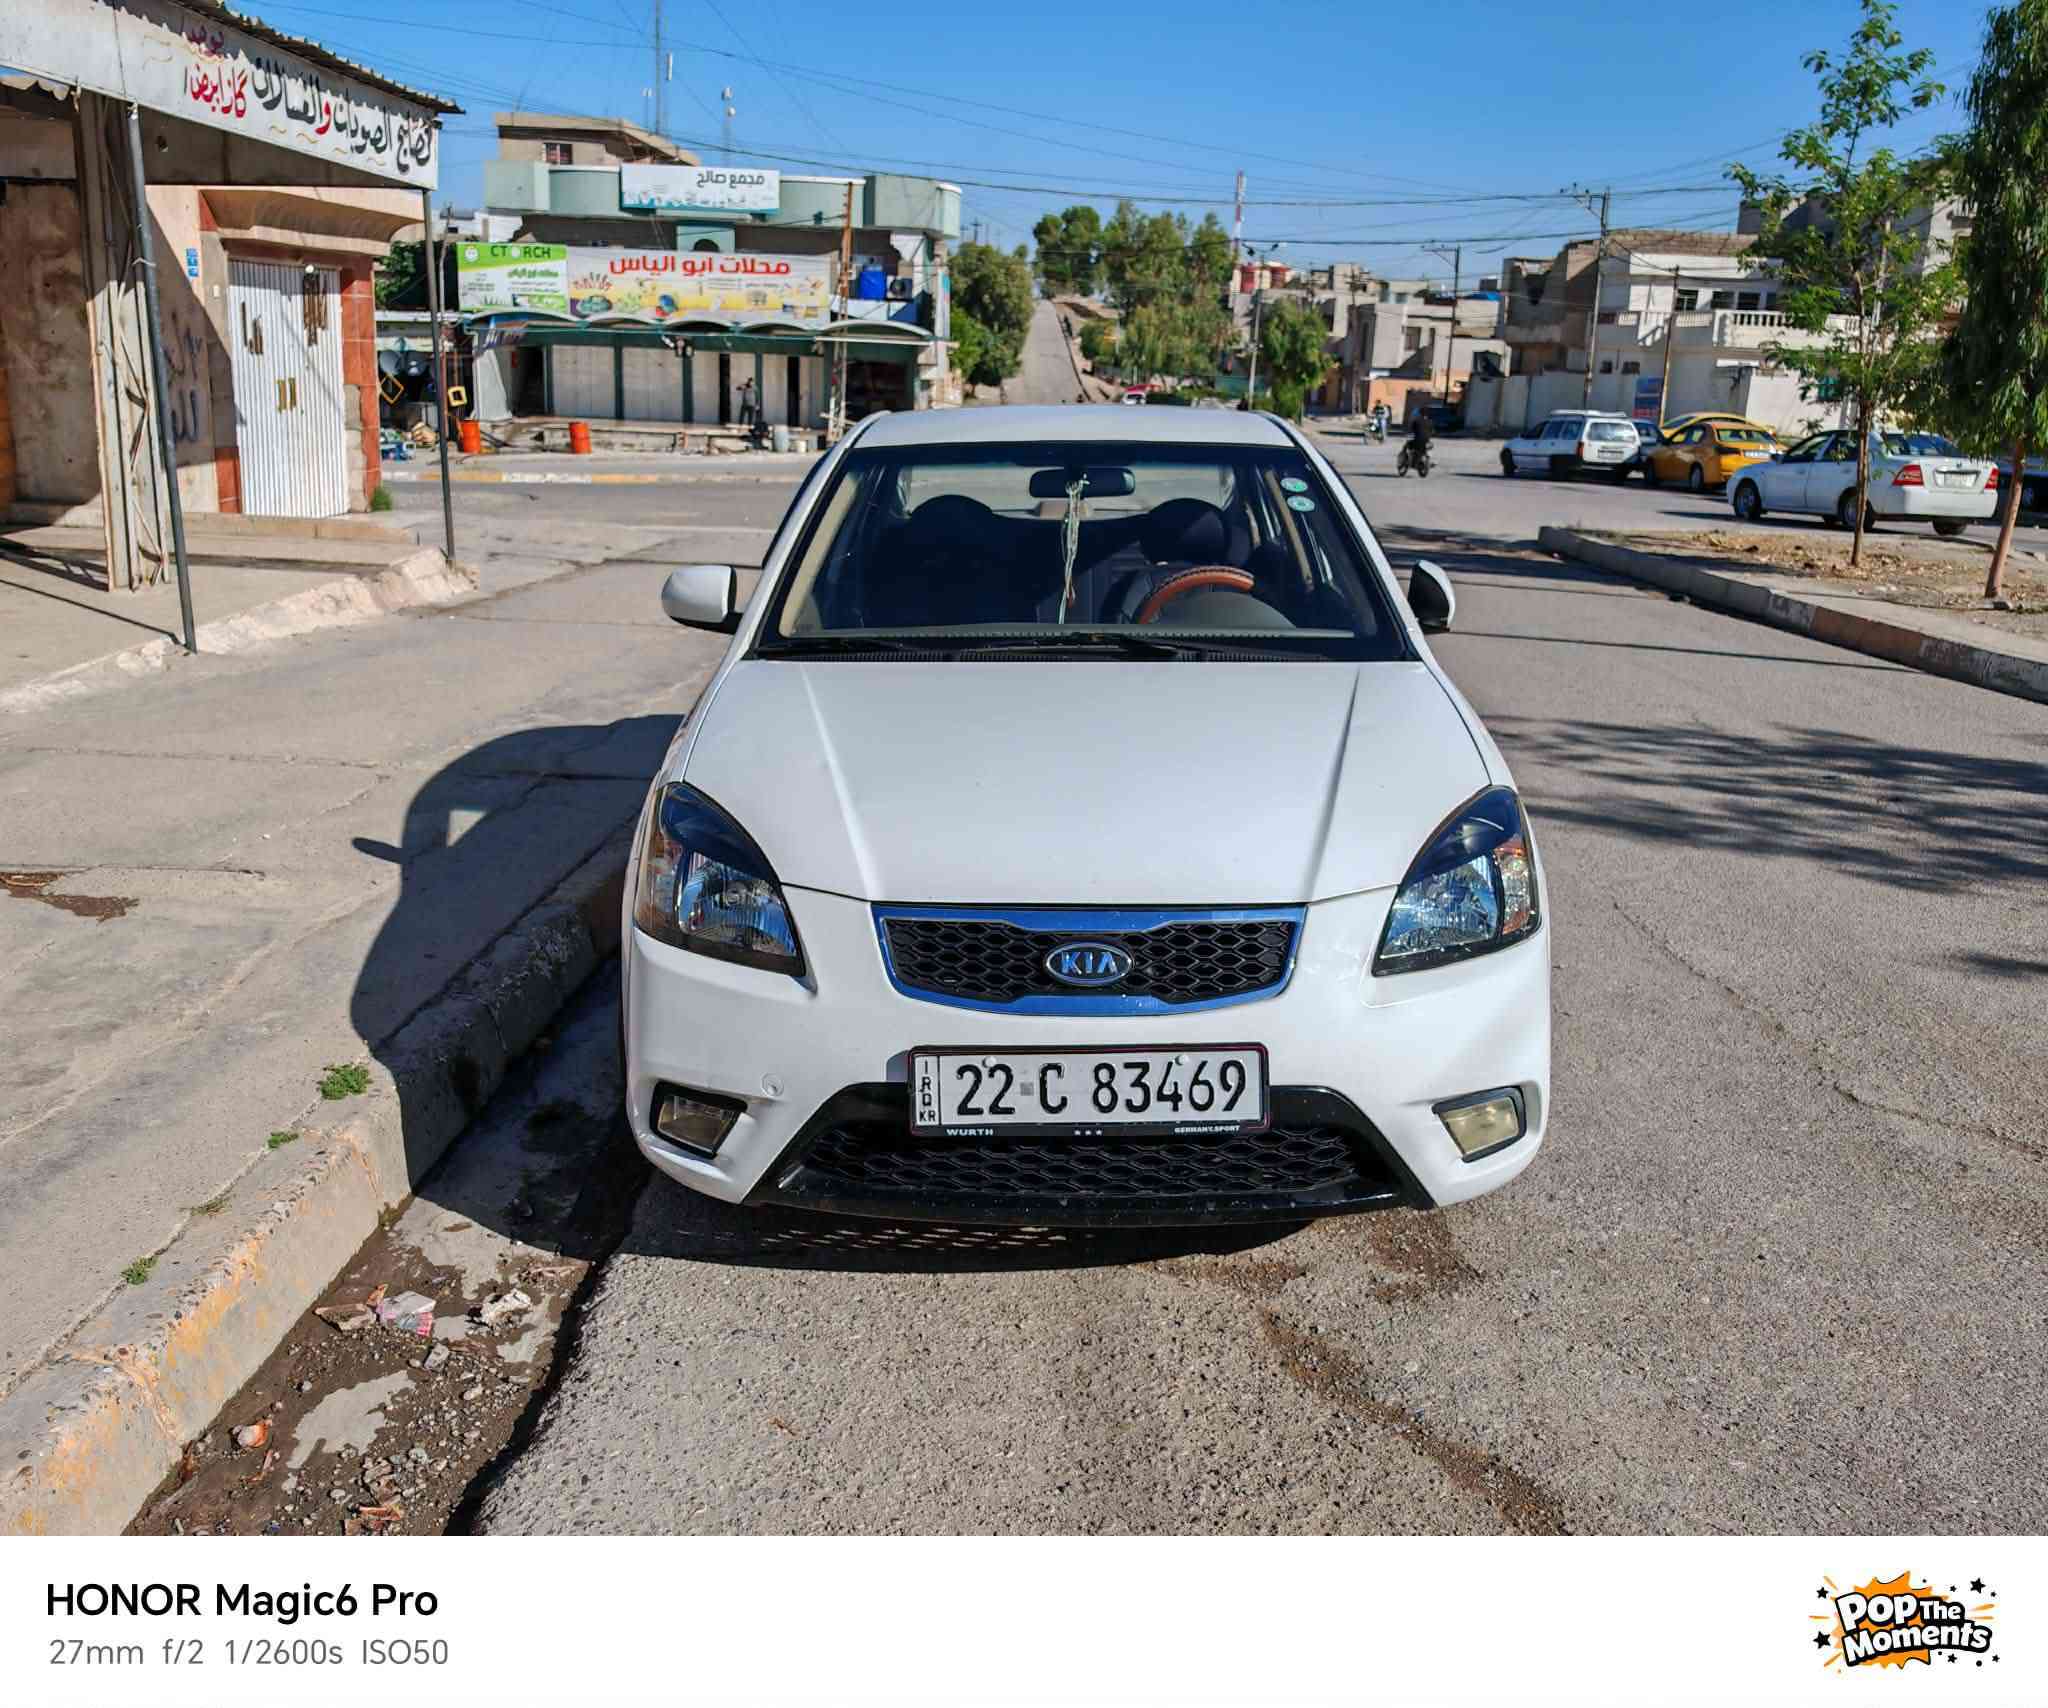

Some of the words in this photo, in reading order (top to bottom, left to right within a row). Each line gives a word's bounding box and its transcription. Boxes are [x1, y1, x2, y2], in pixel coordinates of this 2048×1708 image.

[697, 170, 727, 188] صالح
[729, 174, 765, 189] مجمع
[609, 255, 676, 276] الياس
[682, 256, 712, 277] ابو
[719, 256, 791, 275] محلات
[1061, 950, 1118, 976] KIA
[956, 1063, 1015, 1116] 22
[1038, 1062, 1068, 1115] C
[1092, 1060, 1248, 1114] 83469
[919, 1110, 937, 1124] KR
